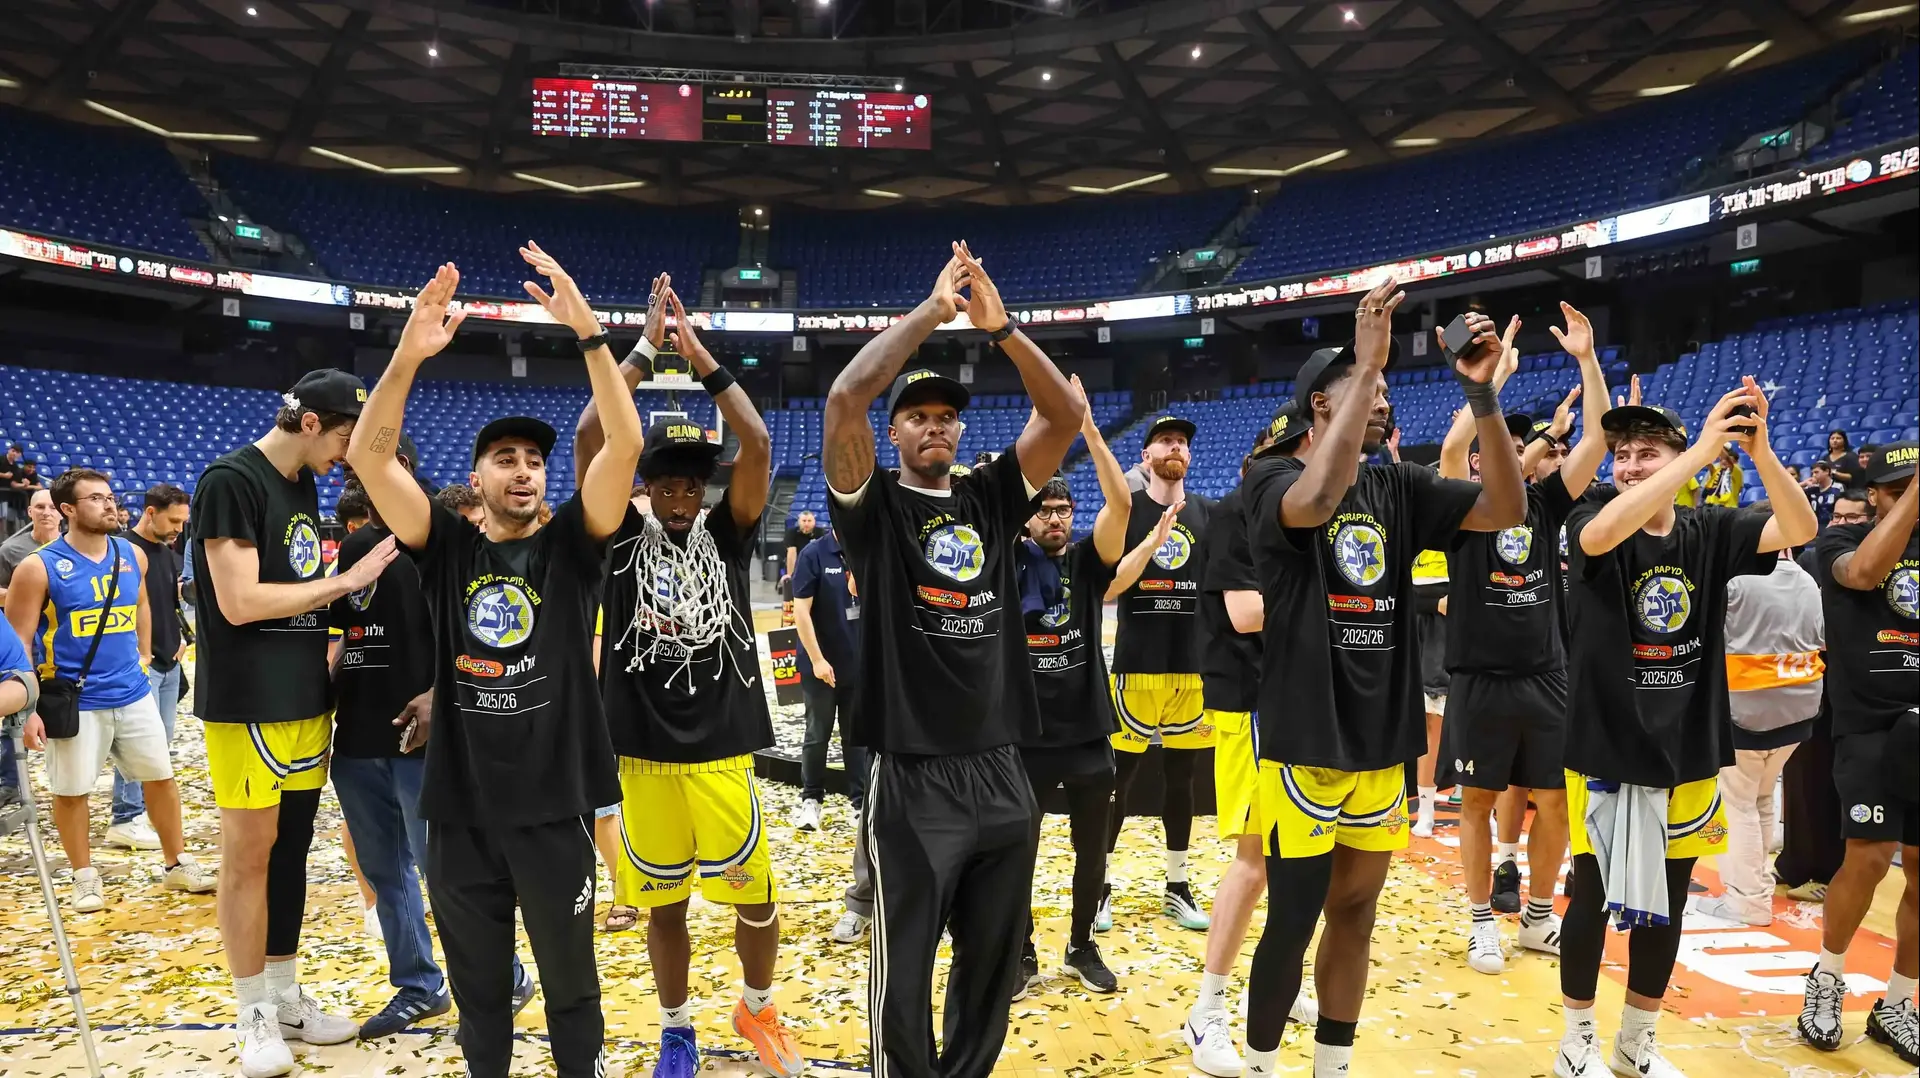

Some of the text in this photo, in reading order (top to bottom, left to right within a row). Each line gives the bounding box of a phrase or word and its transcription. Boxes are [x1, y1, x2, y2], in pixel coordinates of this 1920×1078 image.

[1589, 261, 1597, 276] 7
[228, 302, 236, 315] 4
[1204, 321, 1210, 333] 7
[666, 424, 702, 440] CHAMP
[1654, 565, 1683, 576] RAPYD
[1175, 579, 1197, 590] אלופת
[1154, 599, 1182, 610] 2025/26
[1506, 591, 1538, 604] 2025/26
[289, 612, 317, 627] 025/26
[941, 617, 984, 634] 2025/26
[1341, 628, 1384, 645] 2025/26
[650, 640, 686, 658] 225/26
[1672, 637, 1702, 657] אלופת
[1037, 654, 1069, 669] 2025/26
[1641, 670, 1684, 685] 2025/26
[476, 691, 517, 710] 2025/26
[1464, 760, 1475, 776] 4
[1872, 804, 1884, 824] 6
[656, 877, 684, 891] Rapyd
